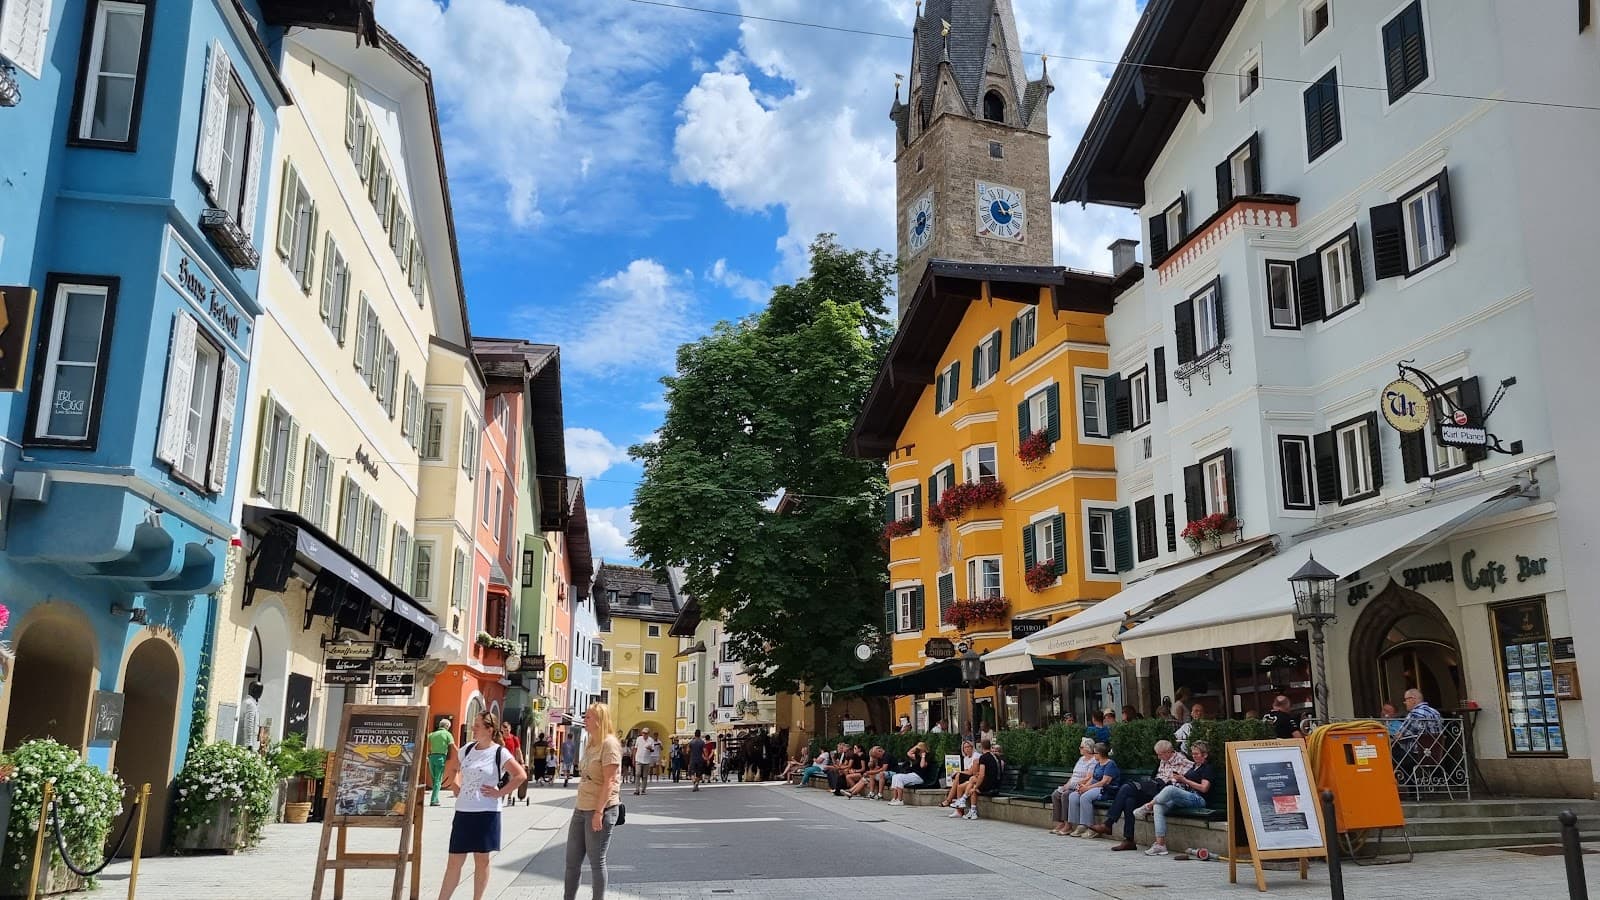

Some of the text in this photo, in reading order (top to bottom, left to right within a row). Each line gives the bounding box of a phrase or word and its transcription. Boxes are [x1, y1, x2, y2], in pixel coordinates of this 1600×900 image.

[1515, 554, 1548, 582] Bar
[553, 667, 563, 679] B
[353, 734, 410, 745] TERRASSE
